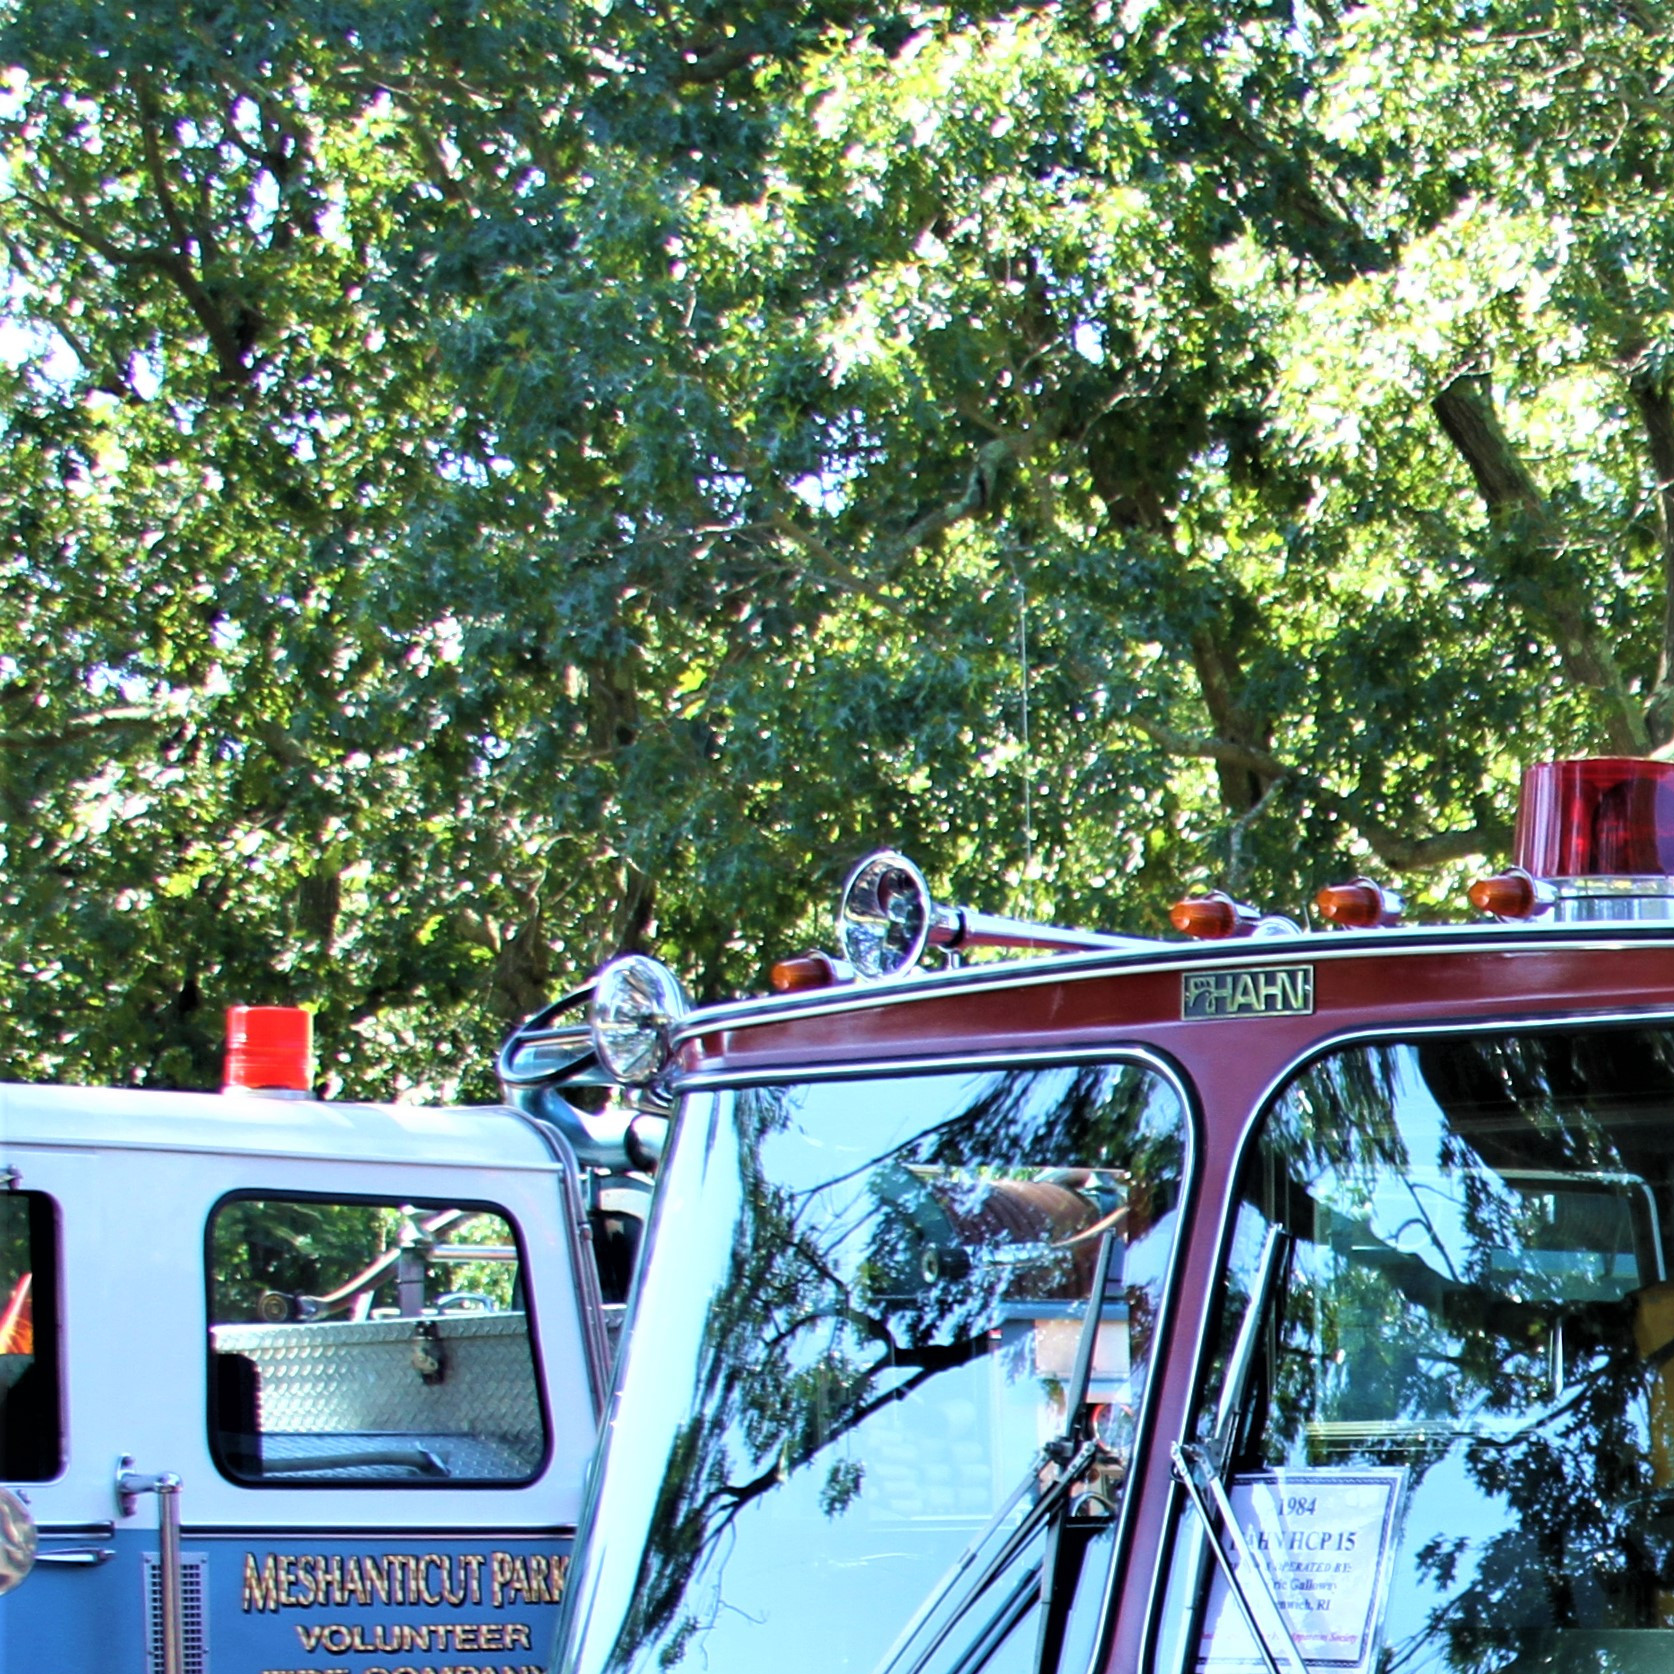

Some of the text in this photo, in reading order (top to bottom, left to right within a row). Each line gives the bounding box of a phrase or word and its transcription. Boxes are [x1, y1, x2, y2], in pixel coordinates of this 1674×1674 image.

[1205, 971, 1305, 1013] HAHN
[1277, 1497, 1318, 1517] 1984
[1288, 1530, 1333, 1552] HCP
[1336, 1531, 1358, 1552] 15
[242, 1552, 486, 1611] MESHANTICUT
[295, 1622, 532, 1653] VOLUNTEER
